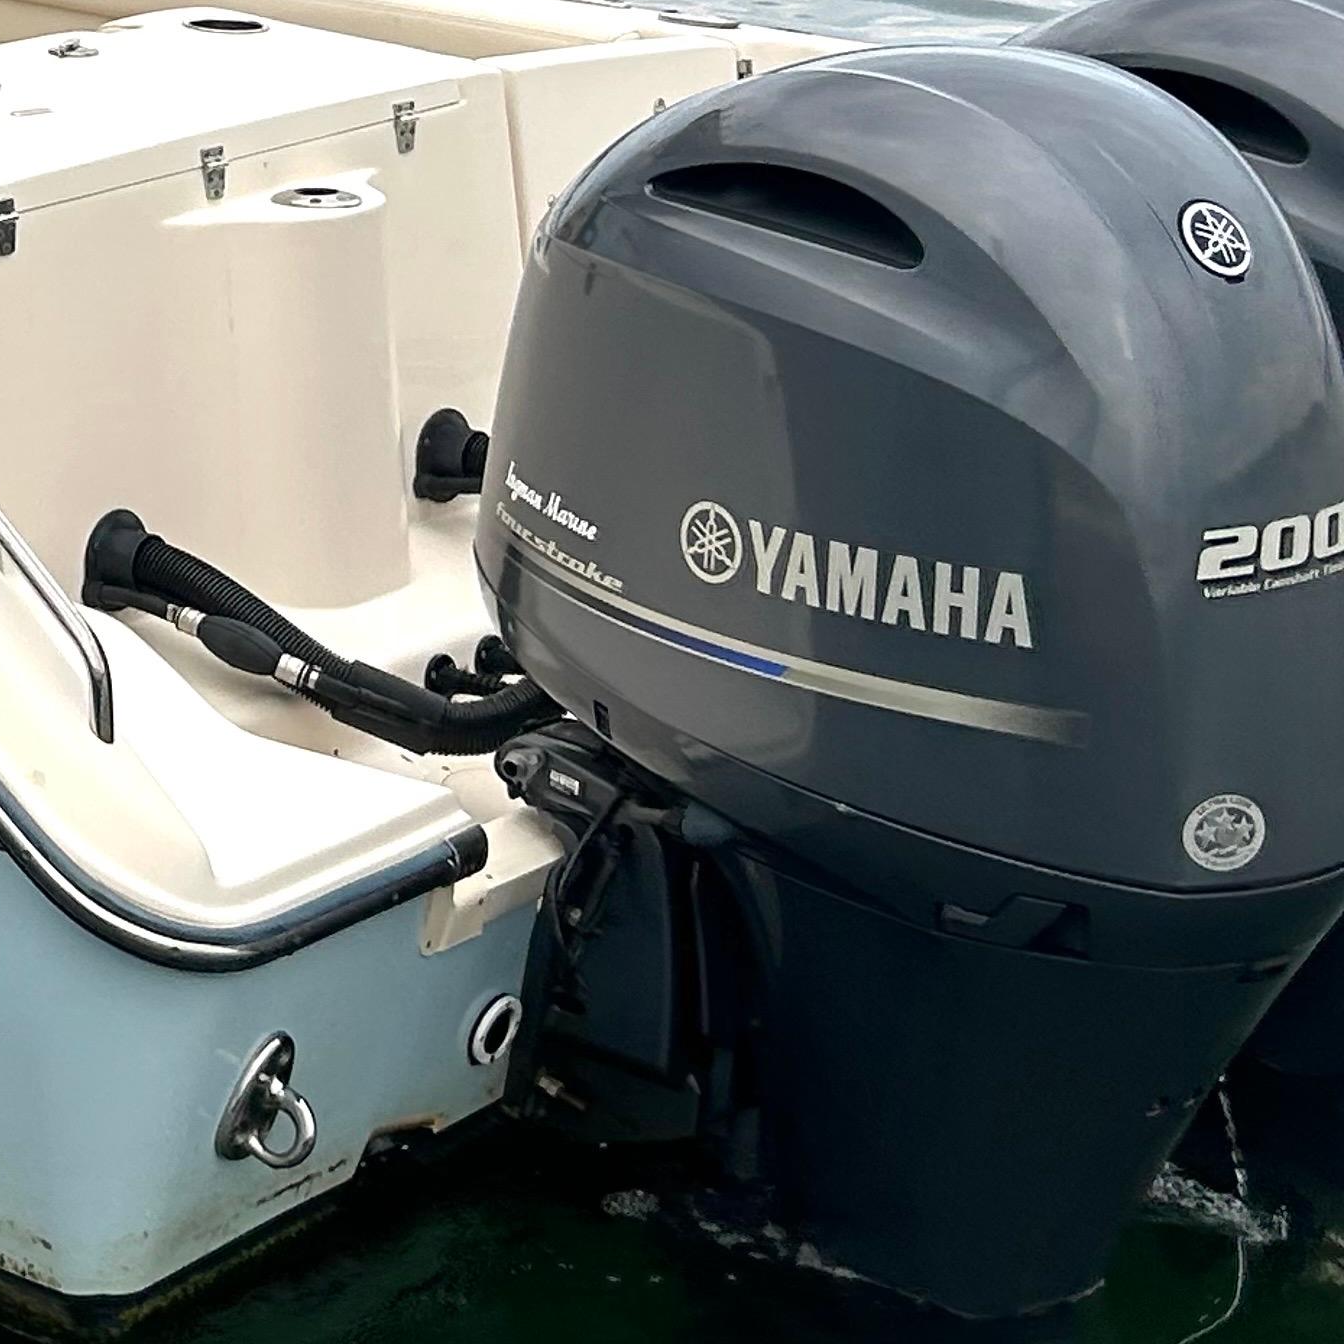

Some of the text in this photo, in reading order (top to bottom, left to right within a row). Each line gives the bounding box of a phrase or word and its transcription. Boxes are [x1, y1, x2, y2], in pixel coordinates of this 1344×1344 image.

[496, 501, 624, 593] fourstroke
[543, 492, 598, 541] Marine
[1197, 501, 1344, 581] 200
[749, 519, 1033, 649] YAMAHA
